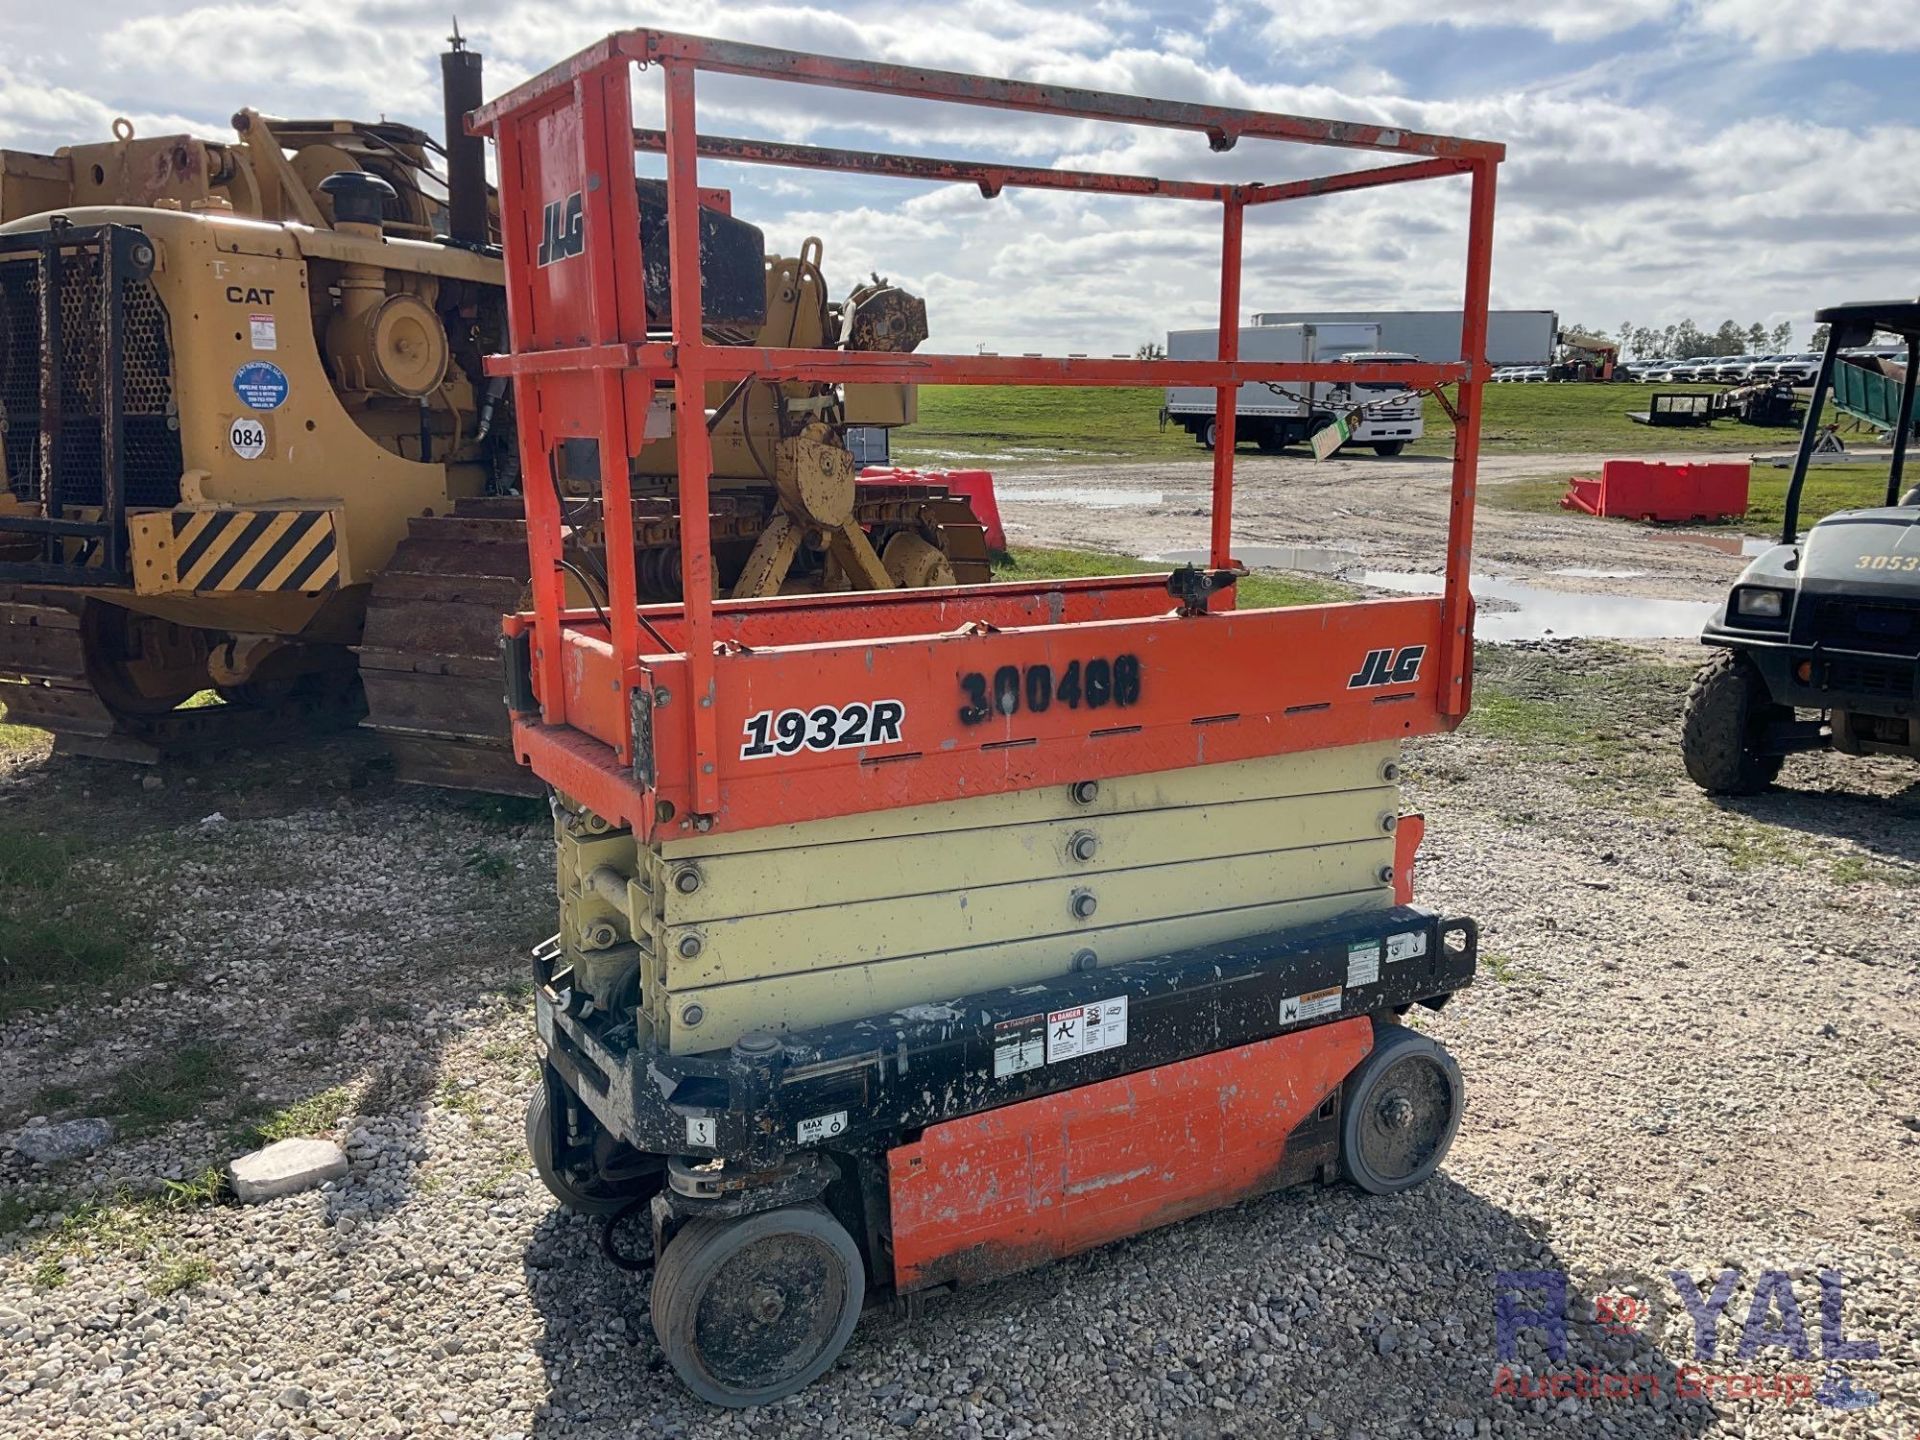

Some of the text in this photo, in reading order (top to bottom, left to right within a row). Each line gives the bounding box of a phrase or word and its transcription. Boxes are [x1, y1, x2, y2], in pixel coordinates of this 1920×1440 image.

[537, 191, 585, 269] JLG
[226, 286, 275, 305] CAT
[232, 429, 263, 446] 084
[1855, 555, 1920, 570] 3053
[1346, 644, 1427, 690] JLG
[741, 700, 904, 759] 1932R
[1057, 1009, 1081, 1020] DANGER
[803, 1119, 823, 1130] MAX
